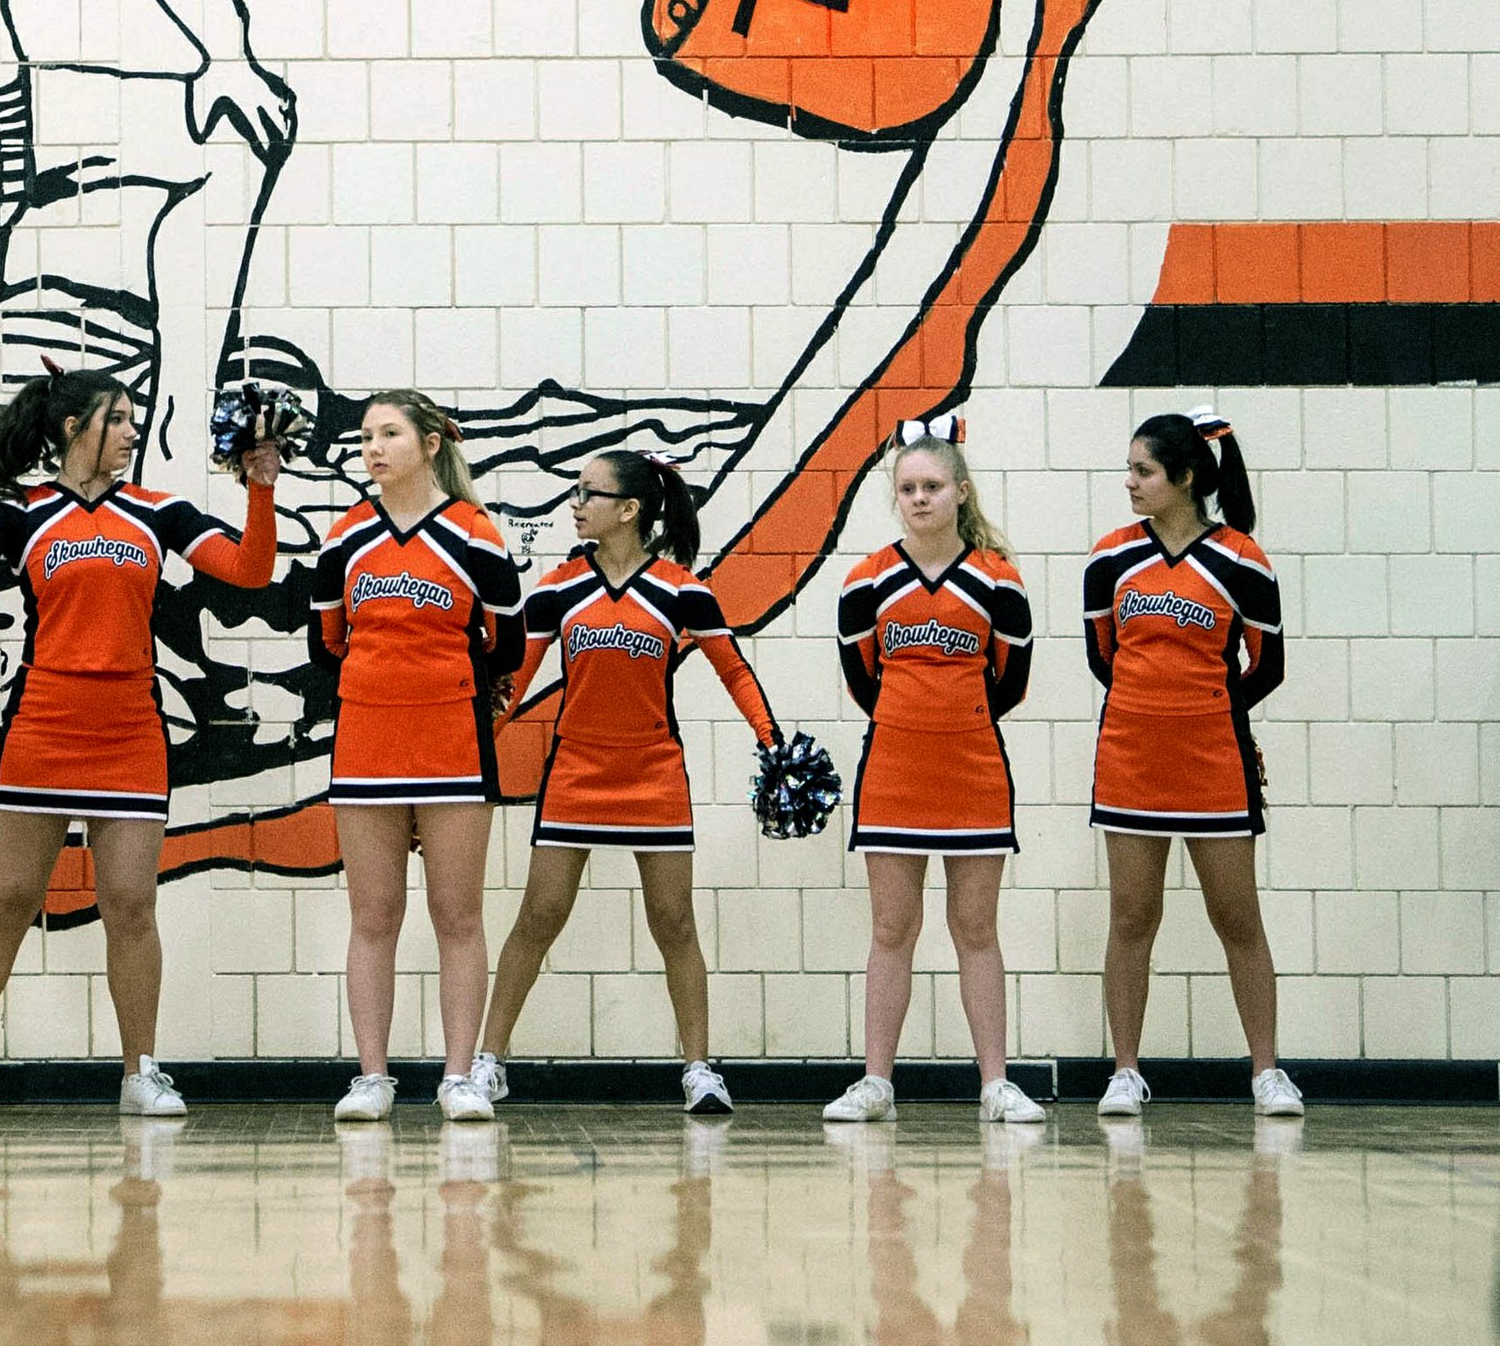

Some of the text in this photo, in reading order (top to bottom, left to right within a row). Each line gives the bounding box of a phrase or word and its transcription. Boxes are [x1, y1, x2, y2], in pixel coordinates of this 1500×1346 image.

[508, 518, 554, 528] Recreated
[45, 534, 147, 580] Skowhegan
[351, 571, 455, 613] Skowhegan
[1117, 591, 1217, 630] Skowhegan
[567, 622, 665, 662] Skowhegan
[883, 619, 980, 658] Skowhegan
